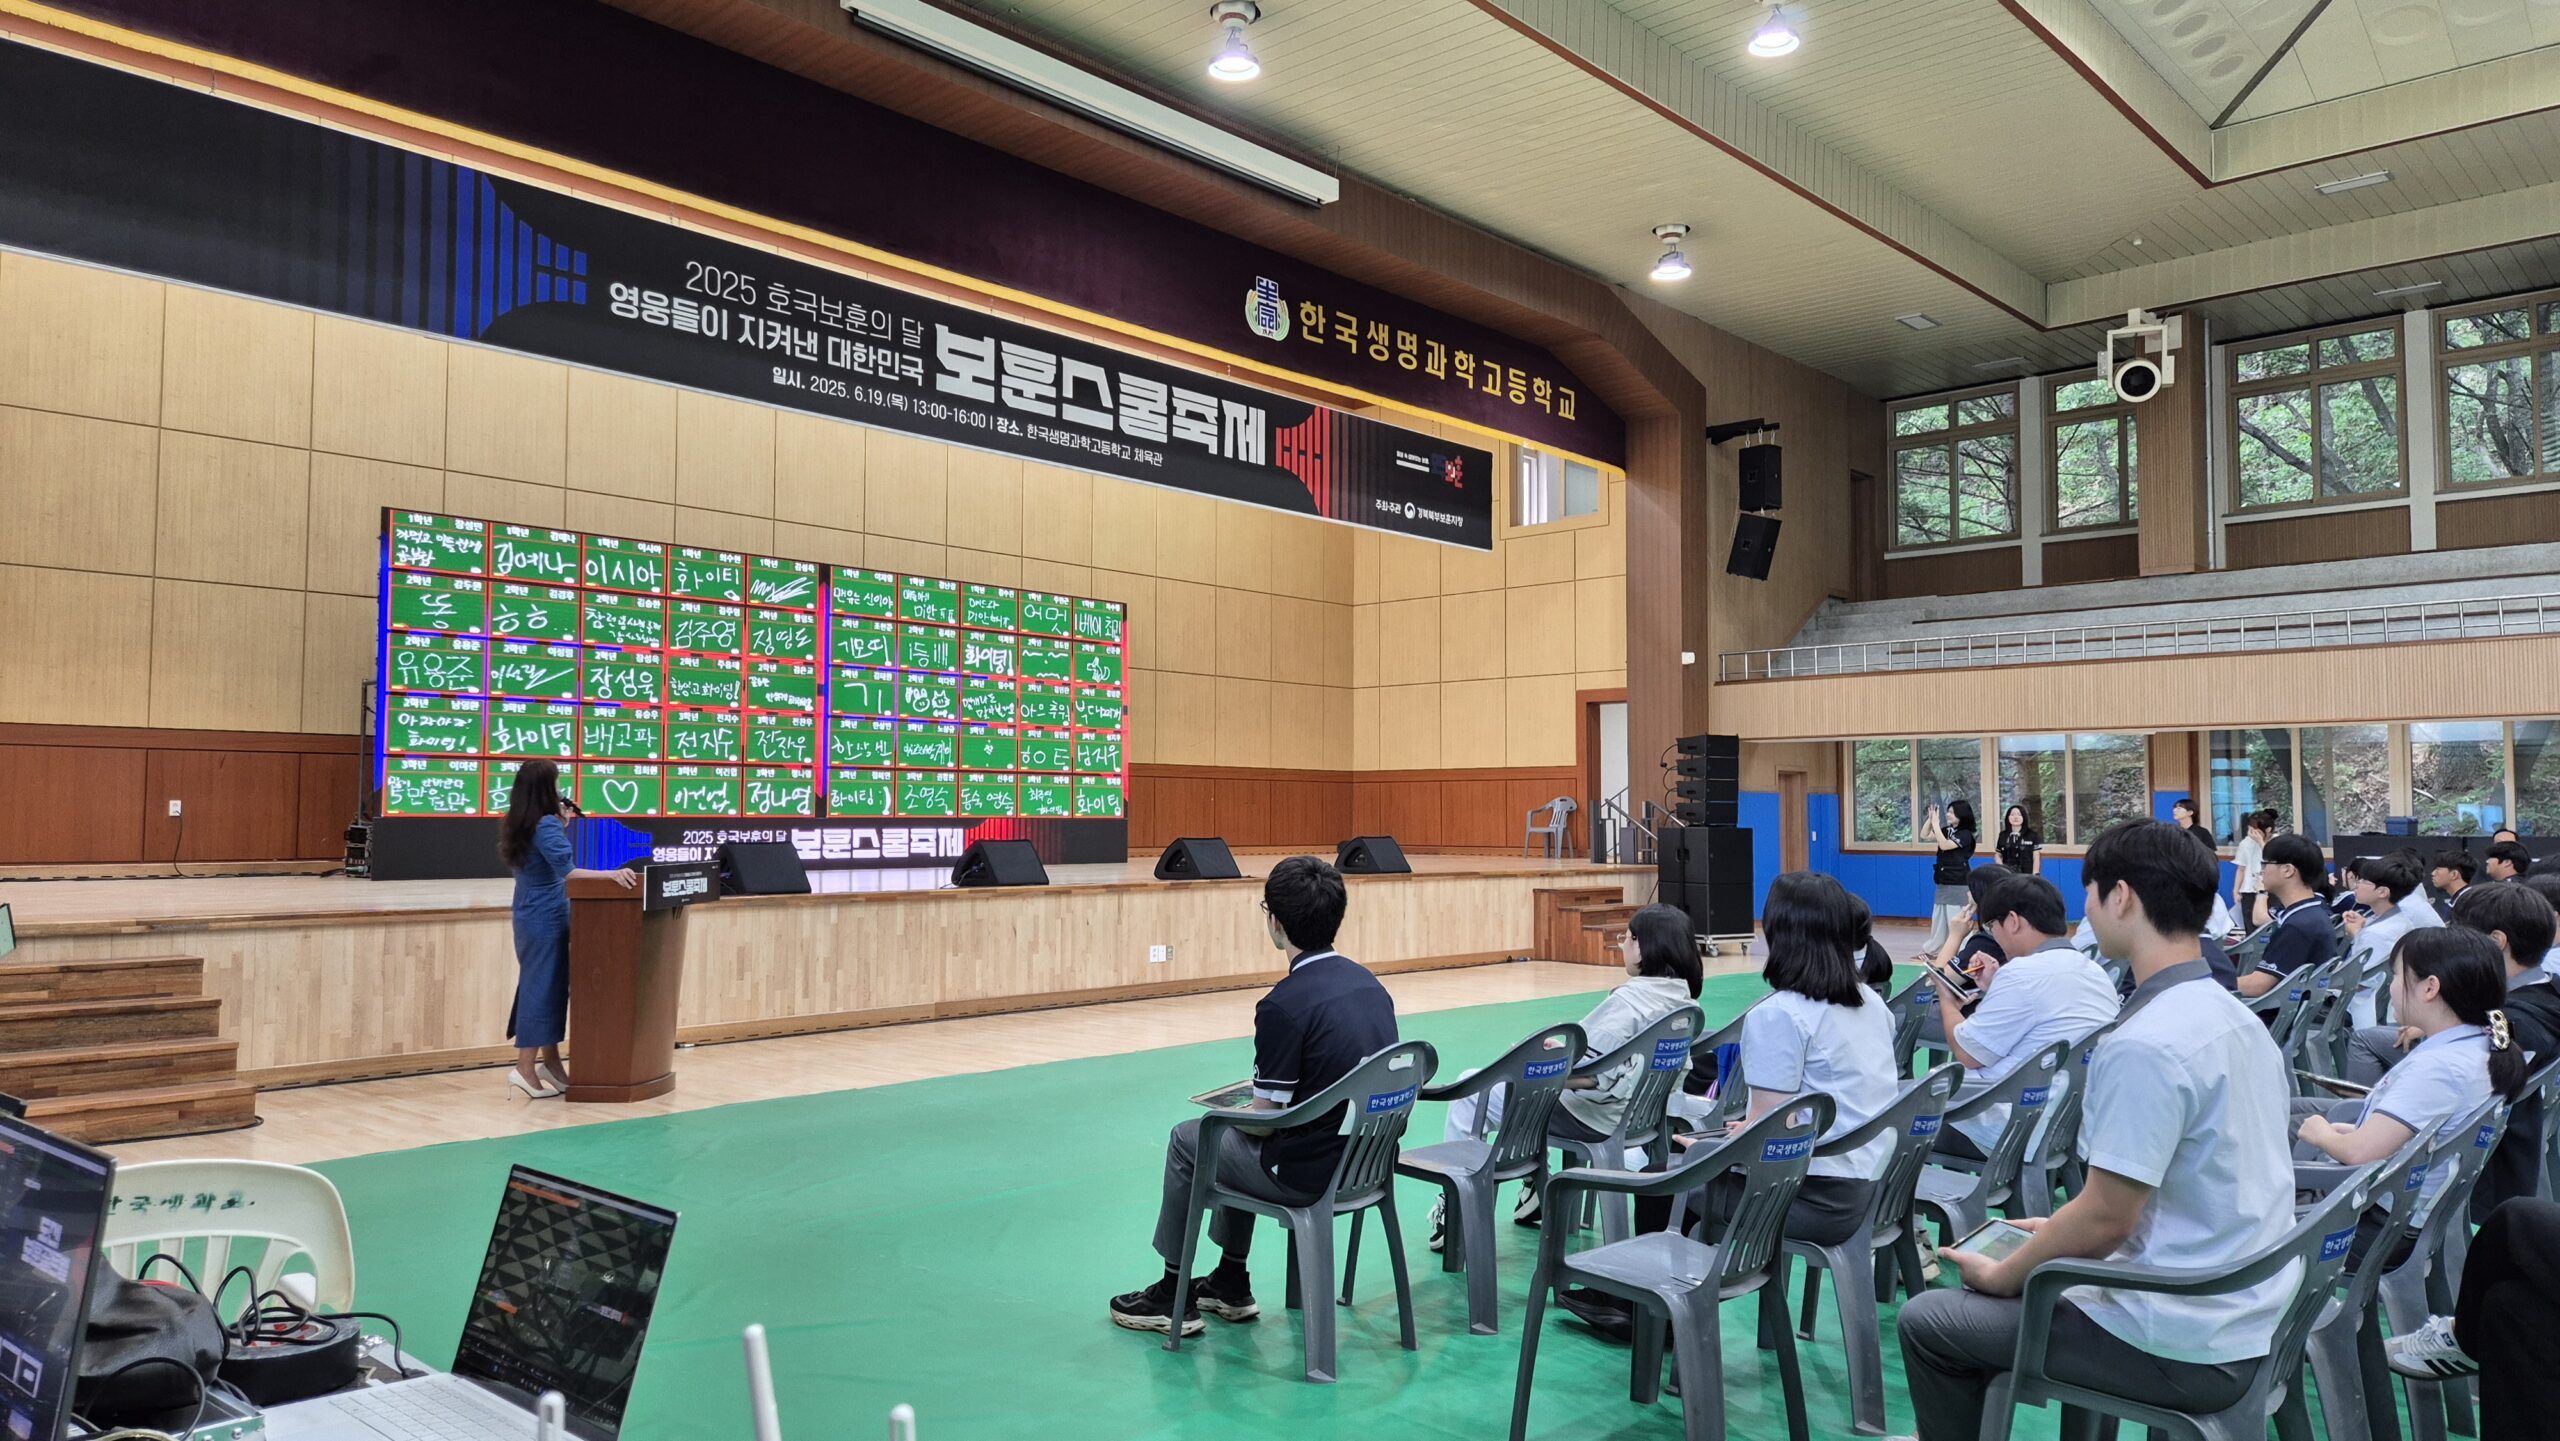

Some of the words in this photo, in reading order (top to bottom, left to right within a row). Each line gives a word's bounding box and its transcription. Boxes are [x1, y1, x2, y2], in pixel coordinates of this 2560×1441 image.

[685, 261, 757, 305] 2025
[766, 282, 892, 341] 호국보훈의
[901, 316, 925, 348] 달
[609, 282, 728, 341] 영웅들이
[737, 312, 818, 362] 지켜낸
[827, 335, 924, 386] 대한민국
[1300, 301, 1576, 421] 한국생명과학고등학교
[934, 323, 1266, 466] 보훈스쿨축제
[772, 366, 805, 389] 일시.
[810, 375, 850, 399] 2025.
[854, 387, 908, 411] 6.19.(목)
[913, 398, 987, 429] 13:00-16:00
[1026, 423, 1131, 460] 한국생명과학고등학교
[1133, 446, 1164, 467] 체육관
[494, 542, 576, 575] 김예나
[585, 555, 662, 585] 이시아
[864, 592, 894, 608] 신이야
[676, 619, 736, 649] 김주영
[398, 652, 475, 691] 유용준
[590, 666, 654, 698] 장성욱
[492, 718, 571, 757] 화이팅
[584, 723, 658, 755] 배고파
[674, 727, 734, 758] 전지수
[748, 782, 812, 813] 정나영
[1076, 788, 1122, 814] 화이팅
[683, 831, 713, 845] 2025
[776, 830, 787, 842] 달
[791, 828, 964, 860] 보훈스쿨축제
[652, 847, 702, 862] 영웅들이
